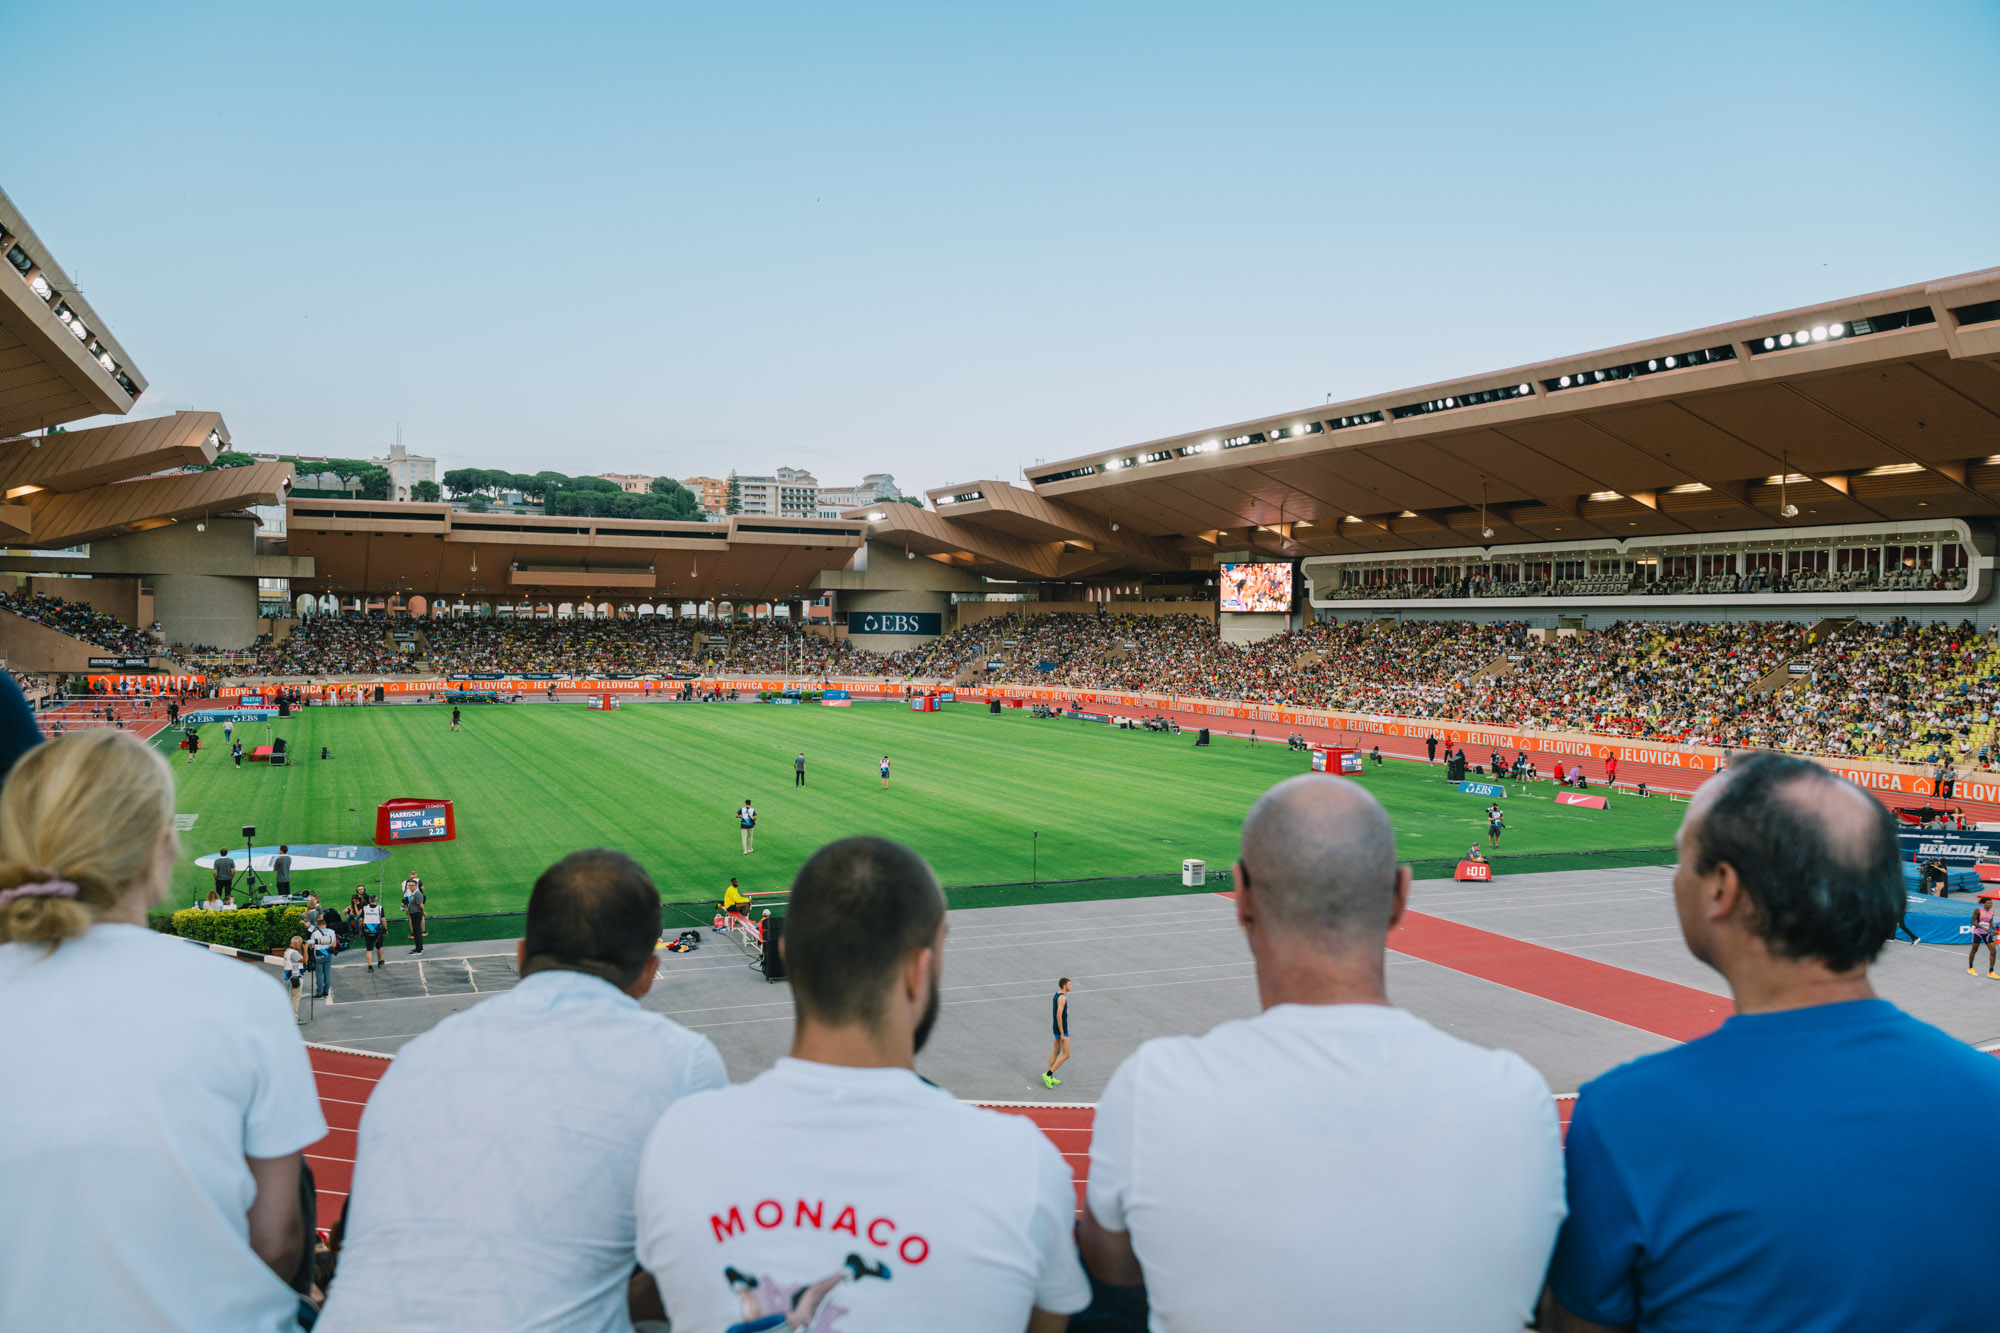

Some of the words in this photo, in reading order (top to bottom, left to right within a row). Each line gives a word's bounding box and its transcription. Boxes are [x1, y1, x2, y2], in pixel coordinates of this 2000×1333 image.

[880, 615, 919, 632] EBS
[404, 682, 448, 691] JELOVICA
[469, 681, 513, 690] JLOVICA
[596, 681, 640, 689] JELOVICA
[659, 681, 701, 689] JELOVCA
[721, 681, 763, 690] JELOVICA
[841, 683, 880, 692] JELOVICA
[897, 684, 935, 694] JEOVICA
[221, 687, 261, 697] JELOVIA
[1004, 689, 1037, 698] JELOVICA
[1051, 692, 1083, 701] JELOVICA
[1168, 701, 1195, 713] JELOVICA
[1206, 705, 1235, 717] JELOVICA
[197, 715, 215, 723] EBS
[241, 714, 259, 722] EBS
[1247, 709, 1280, 723] JELOVICA
[1294, 714, 1329, 728] JELOVICA
[1345, 719, 1385, 734] JELOVICA
[1403, 725, 1445, 741] JELOVICA
[1466, 732, 1514, 748] JELOVICA
[1537, 739, 1592, 757] JELOVICA
[1619, 747, 1681, 767] JELOVICA
[1830, 769, 1902, 791] OVICA
[1475, 785, 1493, 795] EBS
[390, 810, 421, 818] HARRISON
[402, 820, 418, 828] USA
[428, 827, 445, 836] 2.23
[1918, 843, 1989, 857] HERCULIS
[1466, 866, 1486, 876] 1:00
[710, 1198, 930, 1266] MONACO
